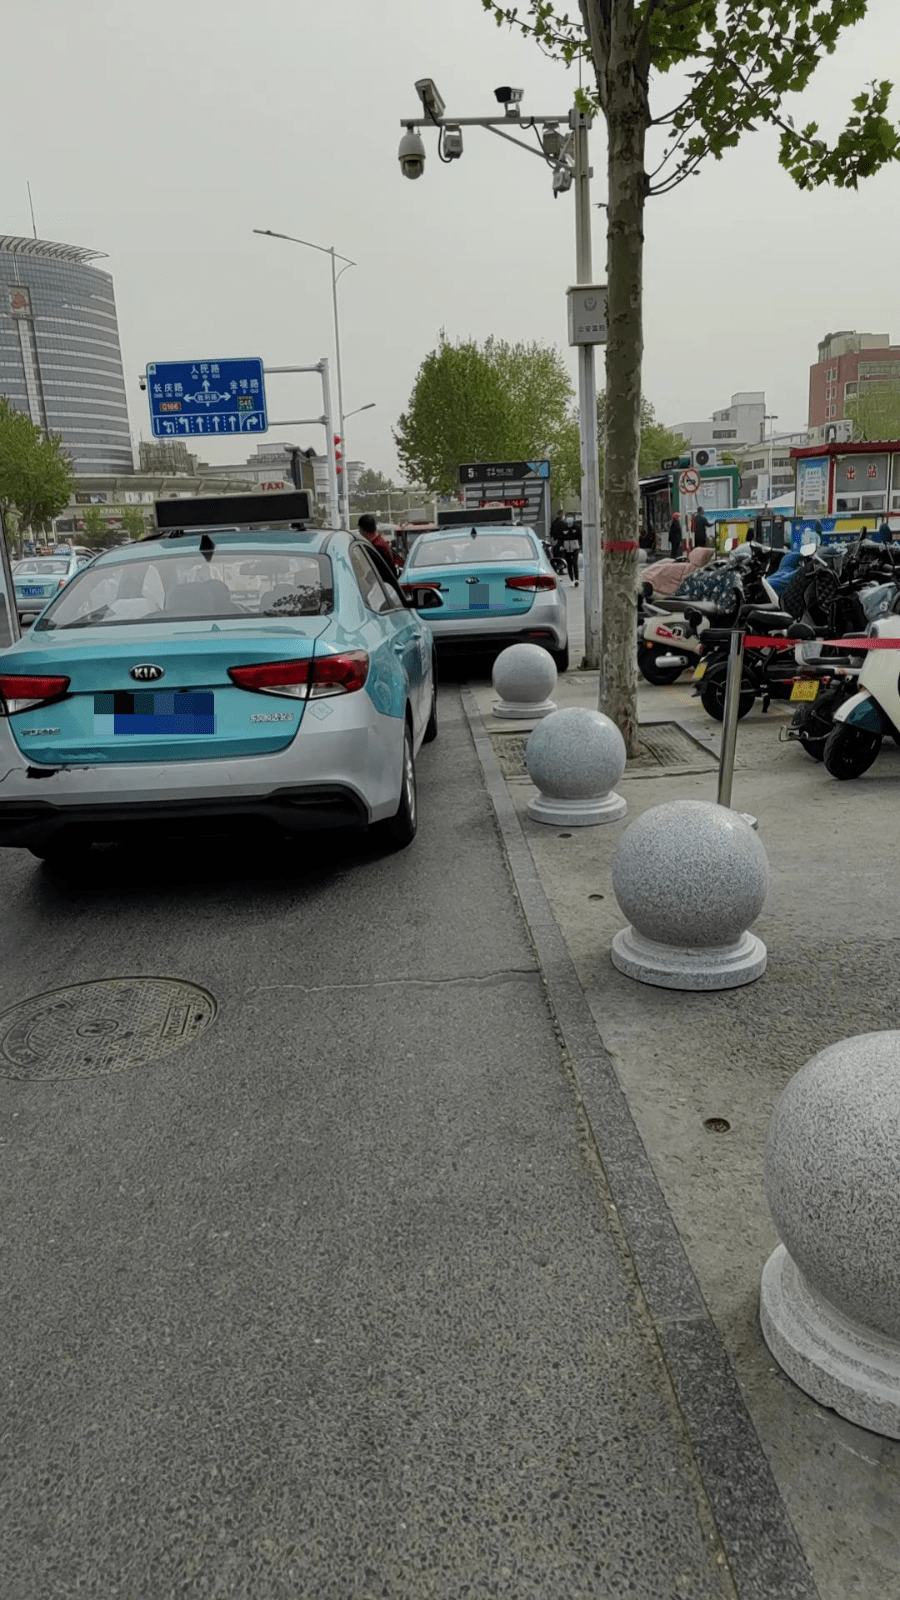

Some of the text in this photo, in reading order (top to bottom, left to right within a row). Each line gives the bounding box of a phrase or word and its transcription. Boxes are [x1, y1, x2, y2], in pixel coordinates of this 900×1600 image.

[190, 364, 220, 375] 人民路
[153, 382, 183, 393] 长庆路
[162, 402, 180, 410] G106
[467, 468, 475, 478] 5
[260, 481, 285, 491] TAXI
[134, 667, 159, 679] KIA
